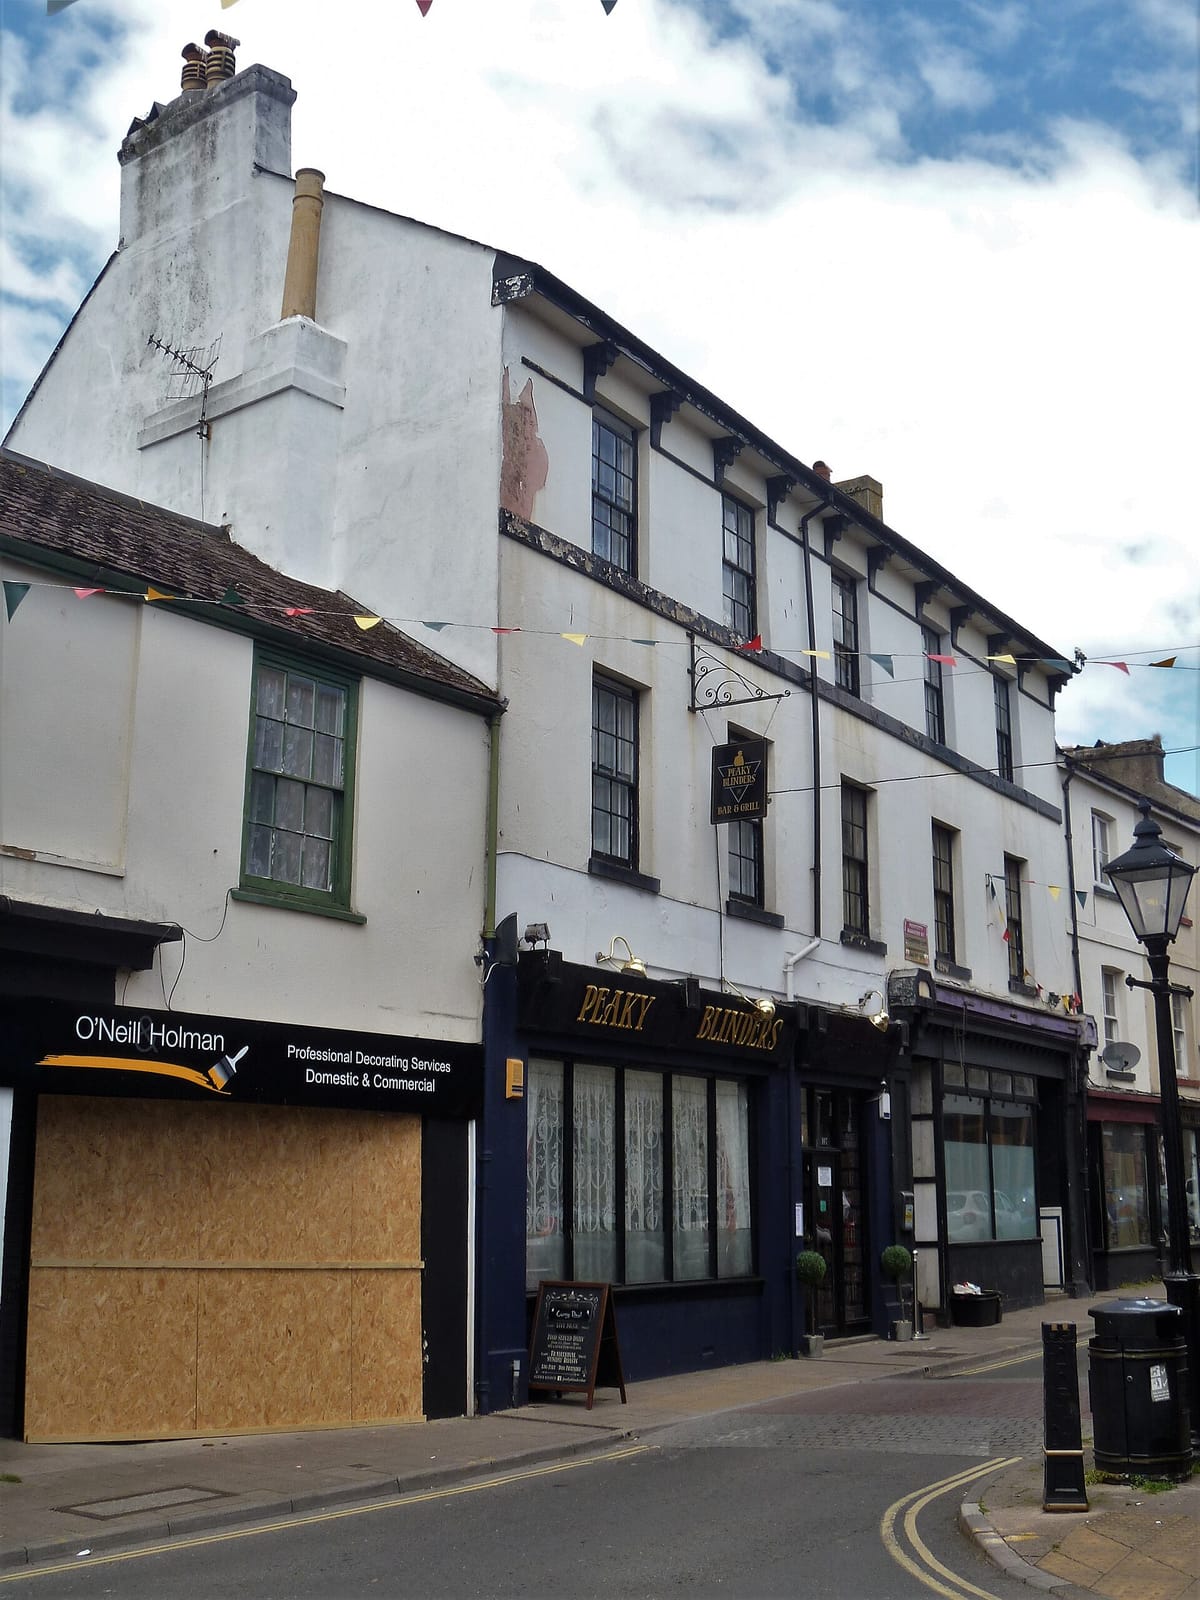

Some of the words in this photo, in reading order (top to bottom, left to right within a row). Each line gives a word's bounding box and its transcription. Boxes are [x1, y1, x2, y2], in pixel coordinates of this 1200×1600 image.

[723, 774, 756, 787] BLINDERS
[728, 766, 751, 777] PEAKY
[717, 805, 732, 816] BAR
[733, 804, 739, 813] &
[740, 801, 760, 812] GRILL
[576, 984, 657, 1031] PEAKY
[696, 1005, 784, 1051] BLINDERS
[75, 1015, 141, 1045] O'Neill
[150, 1022, 225, 1052] Holman
[287, 1044, 353, 1064] Professional
[355, 1051, 409, 1072] Decorating
[411, 1057, 451, 1073] Services
[305, 1068, 360, 1088] Domestic
[362, 1072, 371, 1088] &
[373, 1074, 436, 1093] Commercial
